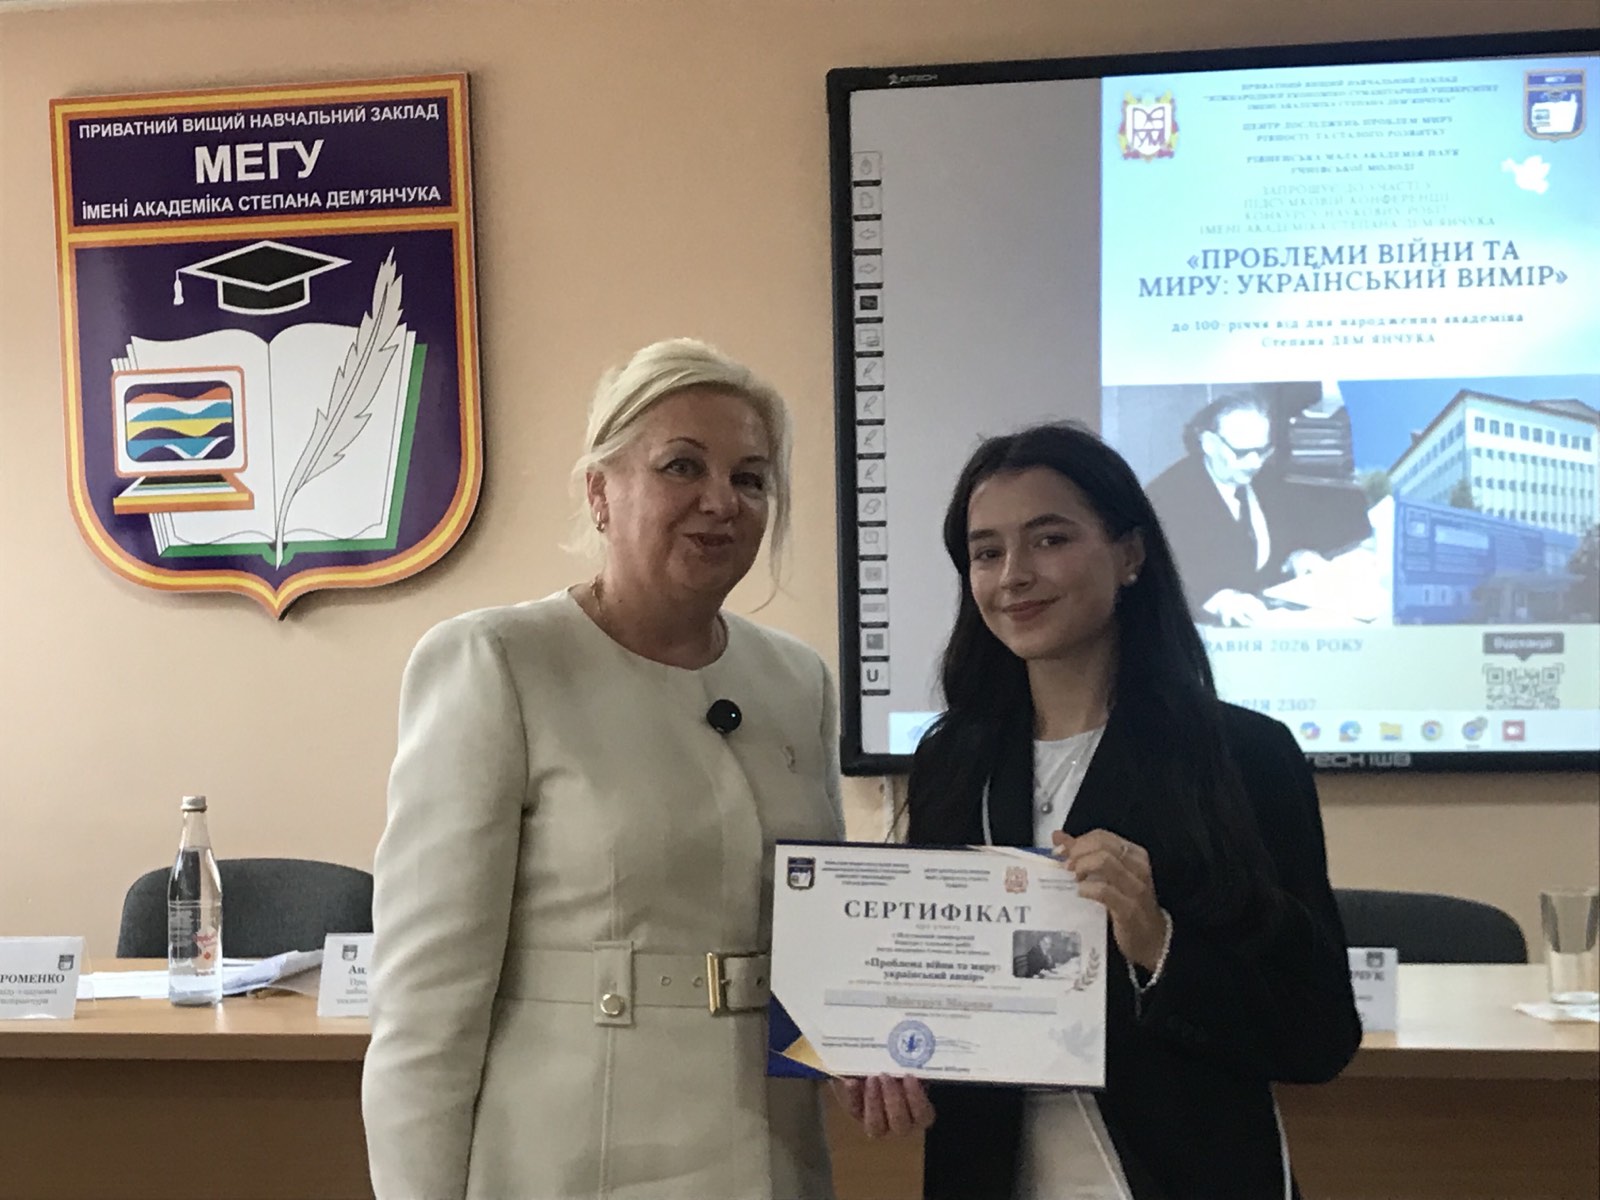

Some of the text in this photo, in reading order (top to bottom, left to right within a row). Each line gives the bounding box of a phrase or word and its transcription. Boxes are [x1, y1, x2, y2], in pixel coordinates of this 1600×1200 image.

[79, 103, 439, 139] ПРИВАТНИЙ ВИЩИЙ НАВЧАЛЬНИЙ ЗАКЛАД
[195, 139, 324, 184] МЕГУ
[82, 185, 441, 220] ІМЕНІ АКАДЕМІКА СТЕПАНА ДЕМ'ЯНЧУКА
[1187, 237, 1520, 270] «ПРОБЛЕМИ ВІЙНИ ТА
[1138, 261, 1569, 299] МИРУ: УКРАЇНСЬКИЙ ВИМІР»
[1172, 322, 1190, 333] до
[1203, 639, 1263, 653] РАВНЯ
[1316, 637, 1364, 653] РОКУ
[844, 900, 1032, 924] СЕРТИФІКАТ
